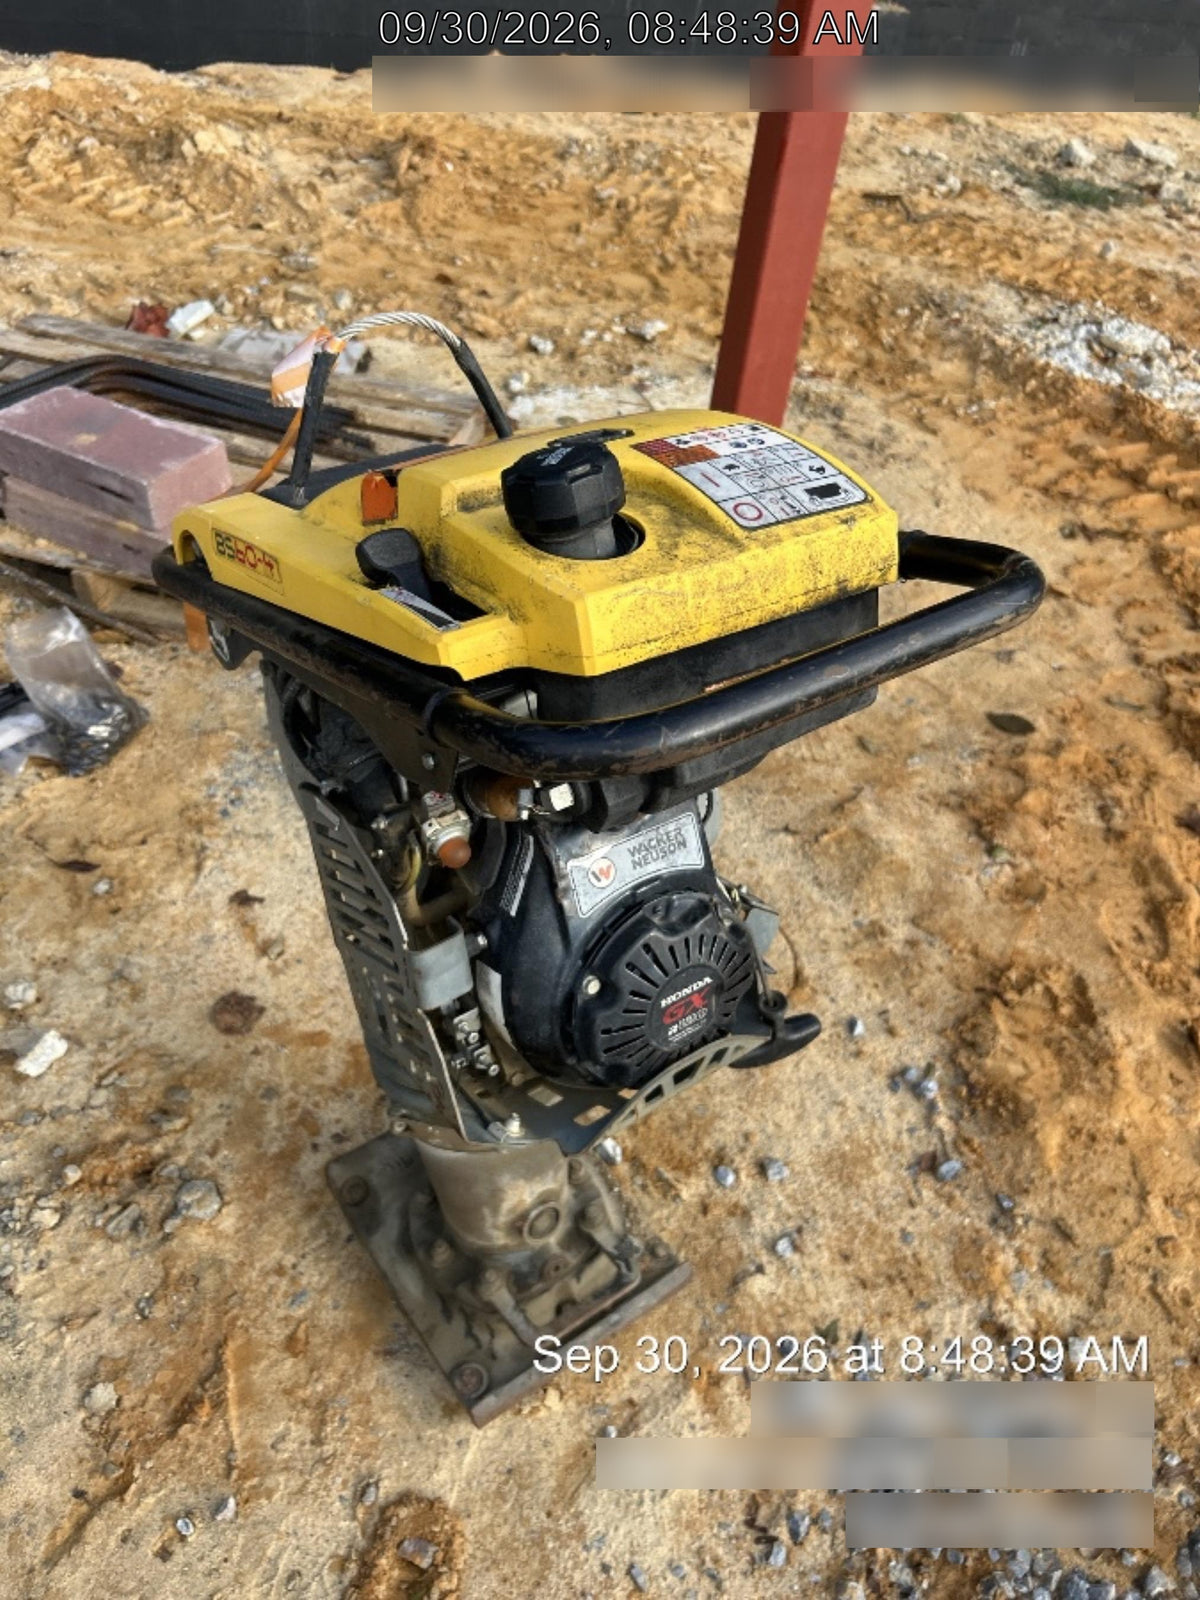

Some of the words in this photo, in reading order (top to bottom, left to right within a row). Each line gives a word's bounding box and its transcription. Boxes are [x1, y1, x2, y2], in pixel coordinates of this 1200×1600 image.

[627, 827, 684, 858] WACKER
[630, 838, 688, 871] NEUSON
[660, 976, 714, 1009] HONDA
[662, 986, 712, 1025] GX
